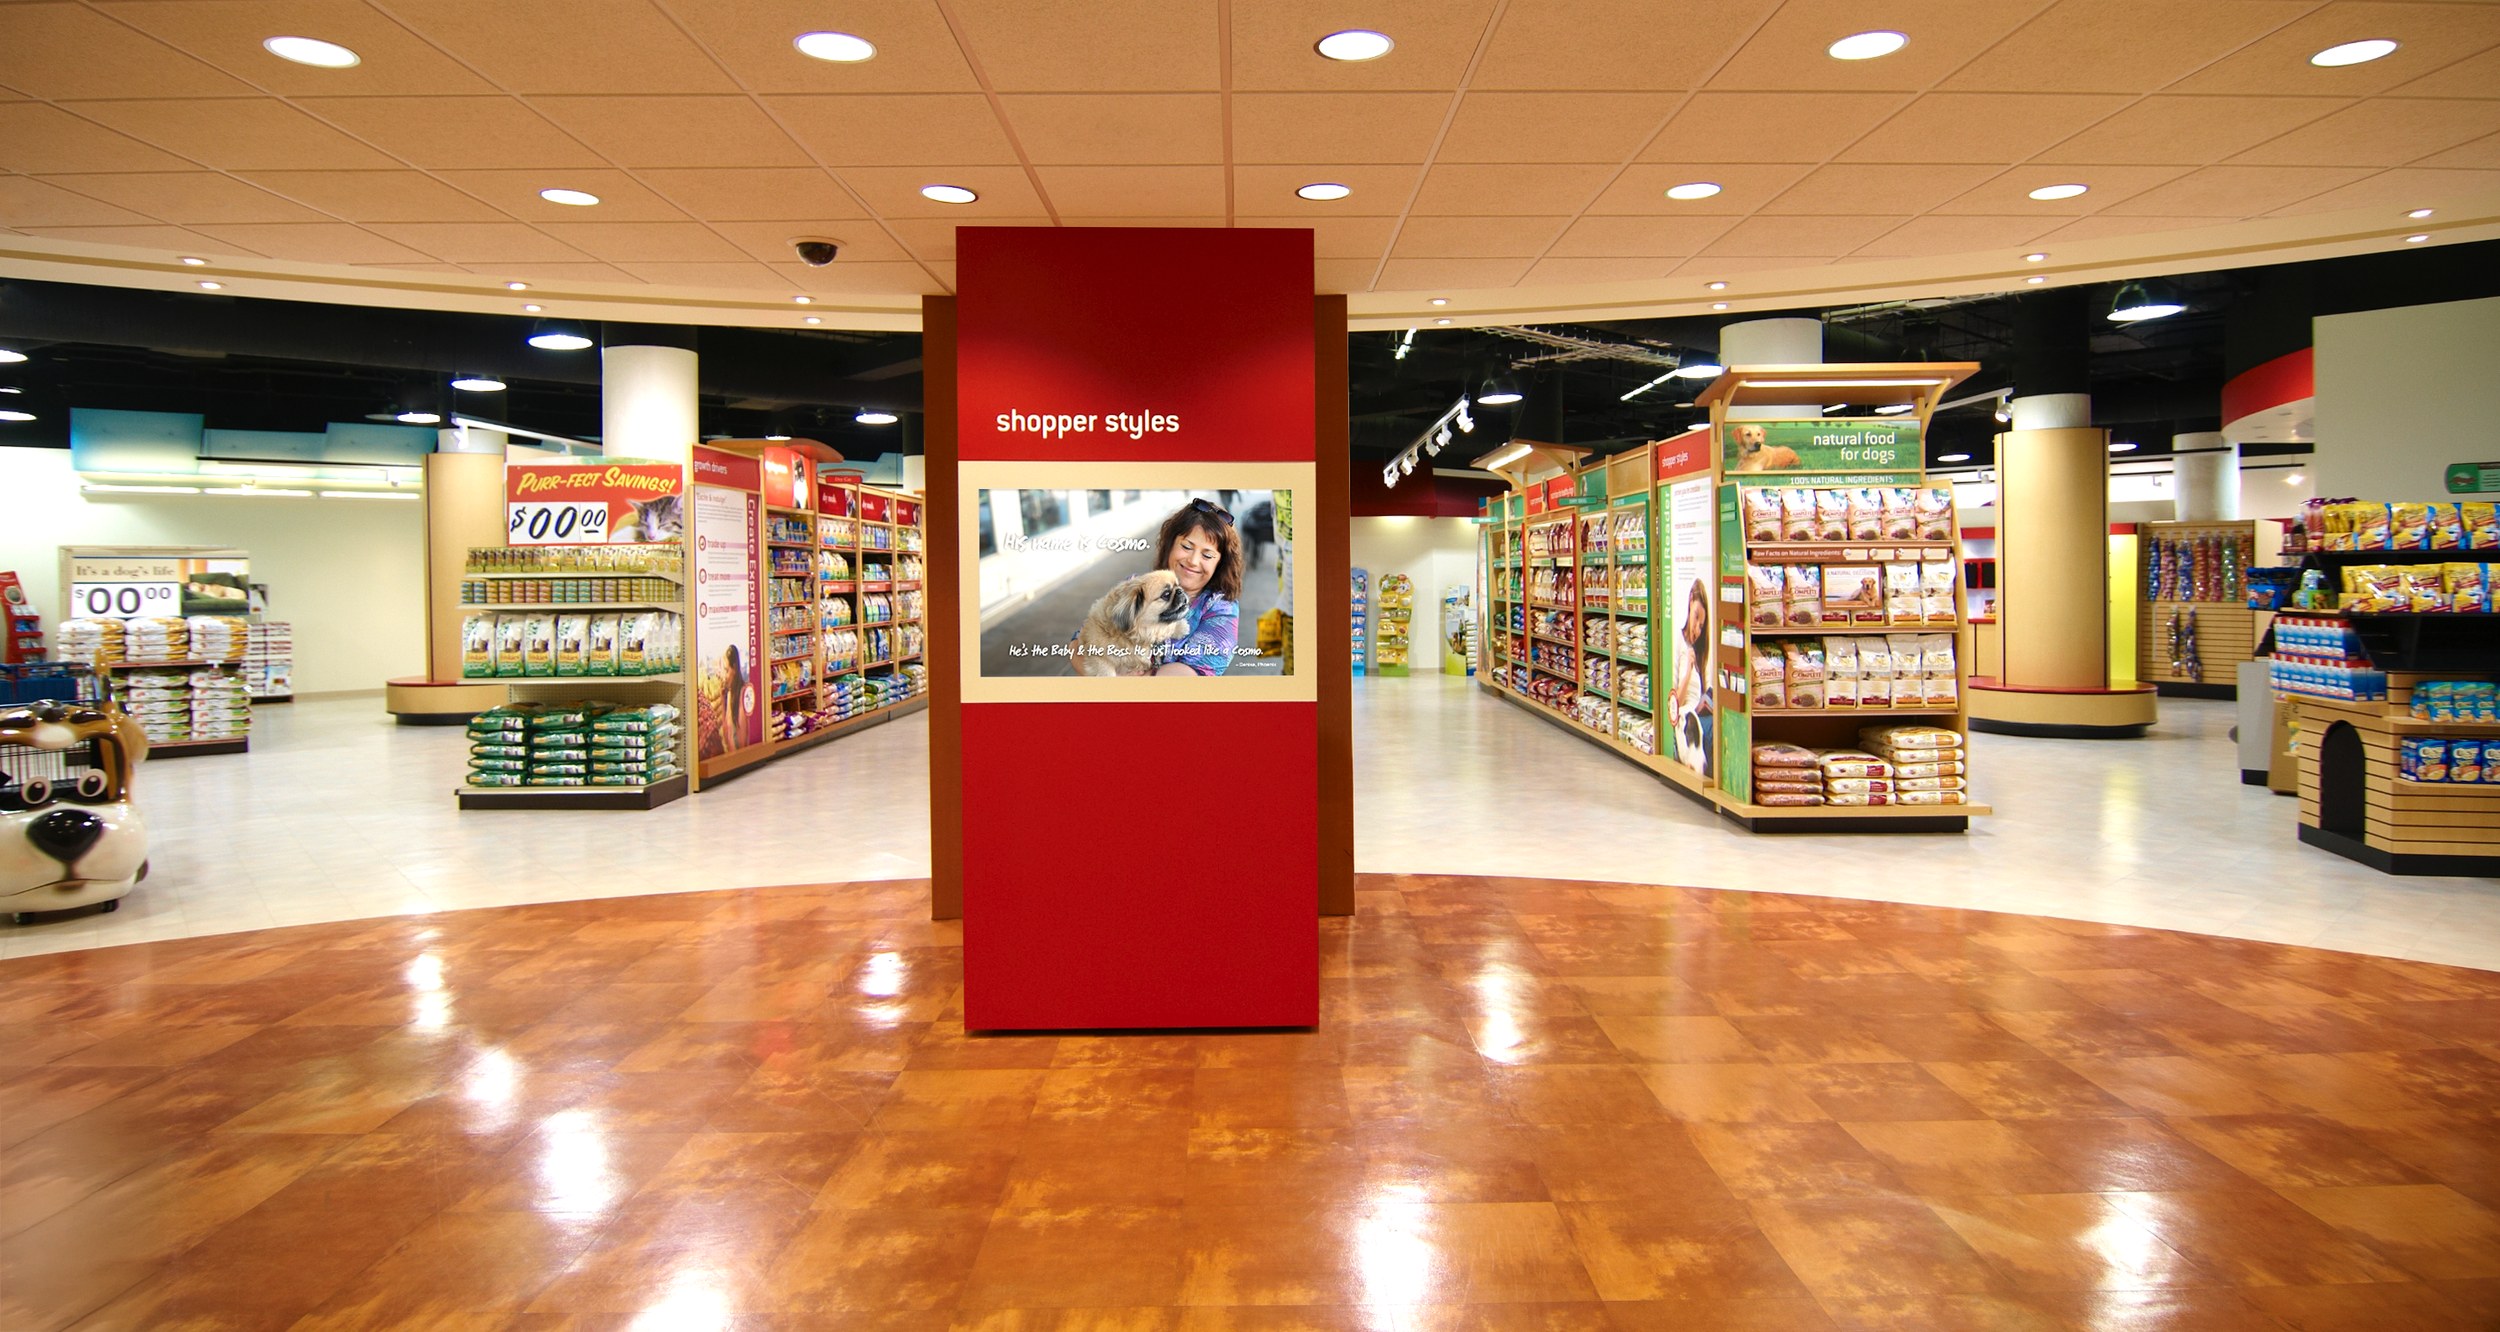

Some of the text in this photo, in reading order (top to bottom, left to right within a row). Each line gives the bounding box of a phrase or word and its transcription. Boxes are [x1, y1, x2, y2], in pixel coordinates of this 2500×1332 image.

[997, 408, 1180, 440] shopper styles
[1813, 432, 1895, 445] natural food
[1662, 456, 1676, 469] shopper
[1841, 448, 1895, 464] for dogs
[694, 460, 711, 473] growth
[516, 466, 677, 496] PURR-FECT SAVINGS!
[1791, 475, 1894, 485] 100% NATURAL INGREDIENTS
[1003, 532, 1151, 553] His name is Cosmo.
[1810, 550, 1842, 558] Ingredients:
[76, 566, 175, 578] It's a dog's life
[748, 499, 757, 668] Create Experiences
[1009, 643, 1029, 657] He's
[1031, 644, 1049, 657] the
[1051, 644, 1075, 660] Baby
[1077, 644, 1085, 656] &
[1087, 644, 1104, 657] the
[1107, 644, 1131, 657] Boss.
[1134, 645, 1146, 656] He
[1147, 644, 1171, 659] just
[1171, 644, 1201, 656] looked
[1203, 644, 1220, 656] like
[1231, 645, 1264, 657] Cosmo.
